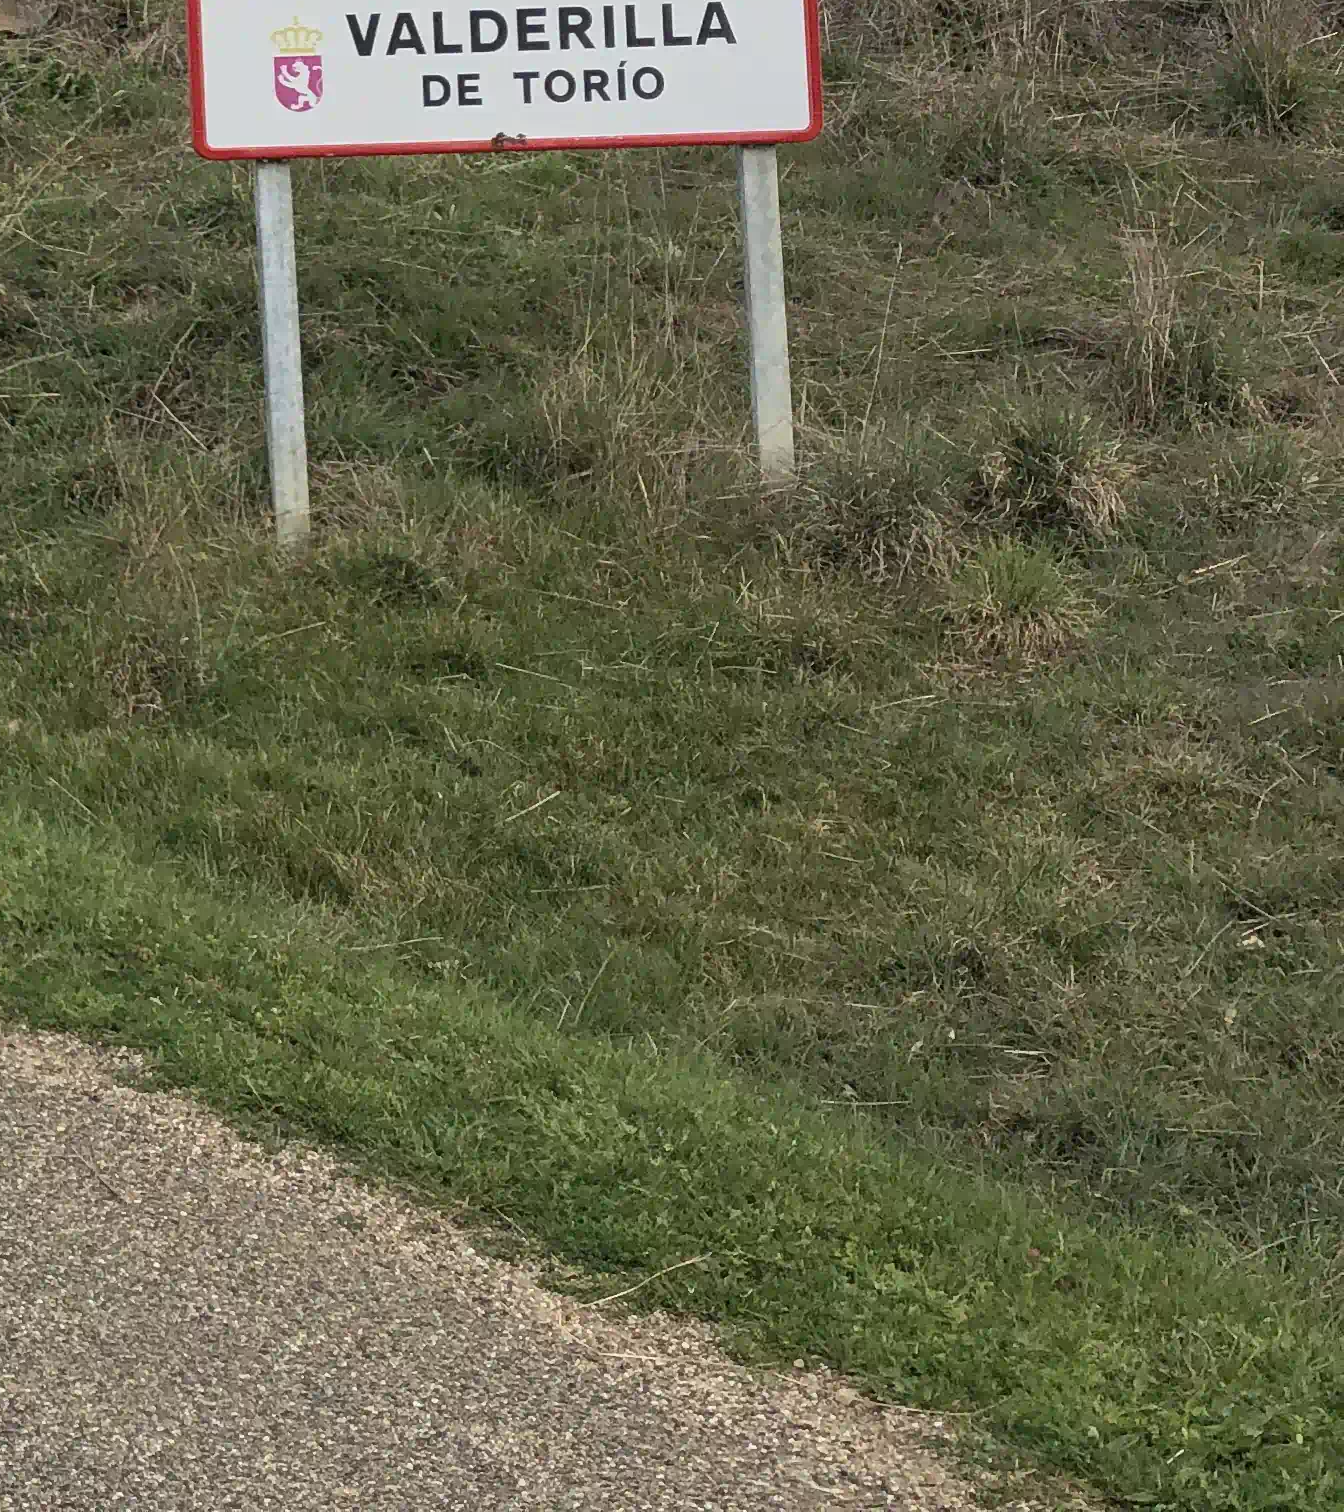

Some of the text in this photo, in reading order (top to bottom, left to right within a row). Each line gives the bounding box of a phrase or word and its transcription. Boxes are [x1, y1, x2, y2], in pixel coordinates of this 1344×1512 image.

[344, 0, 738, 57] VALDERILLA
[421, 60, 665, 107] DE TORÍO
